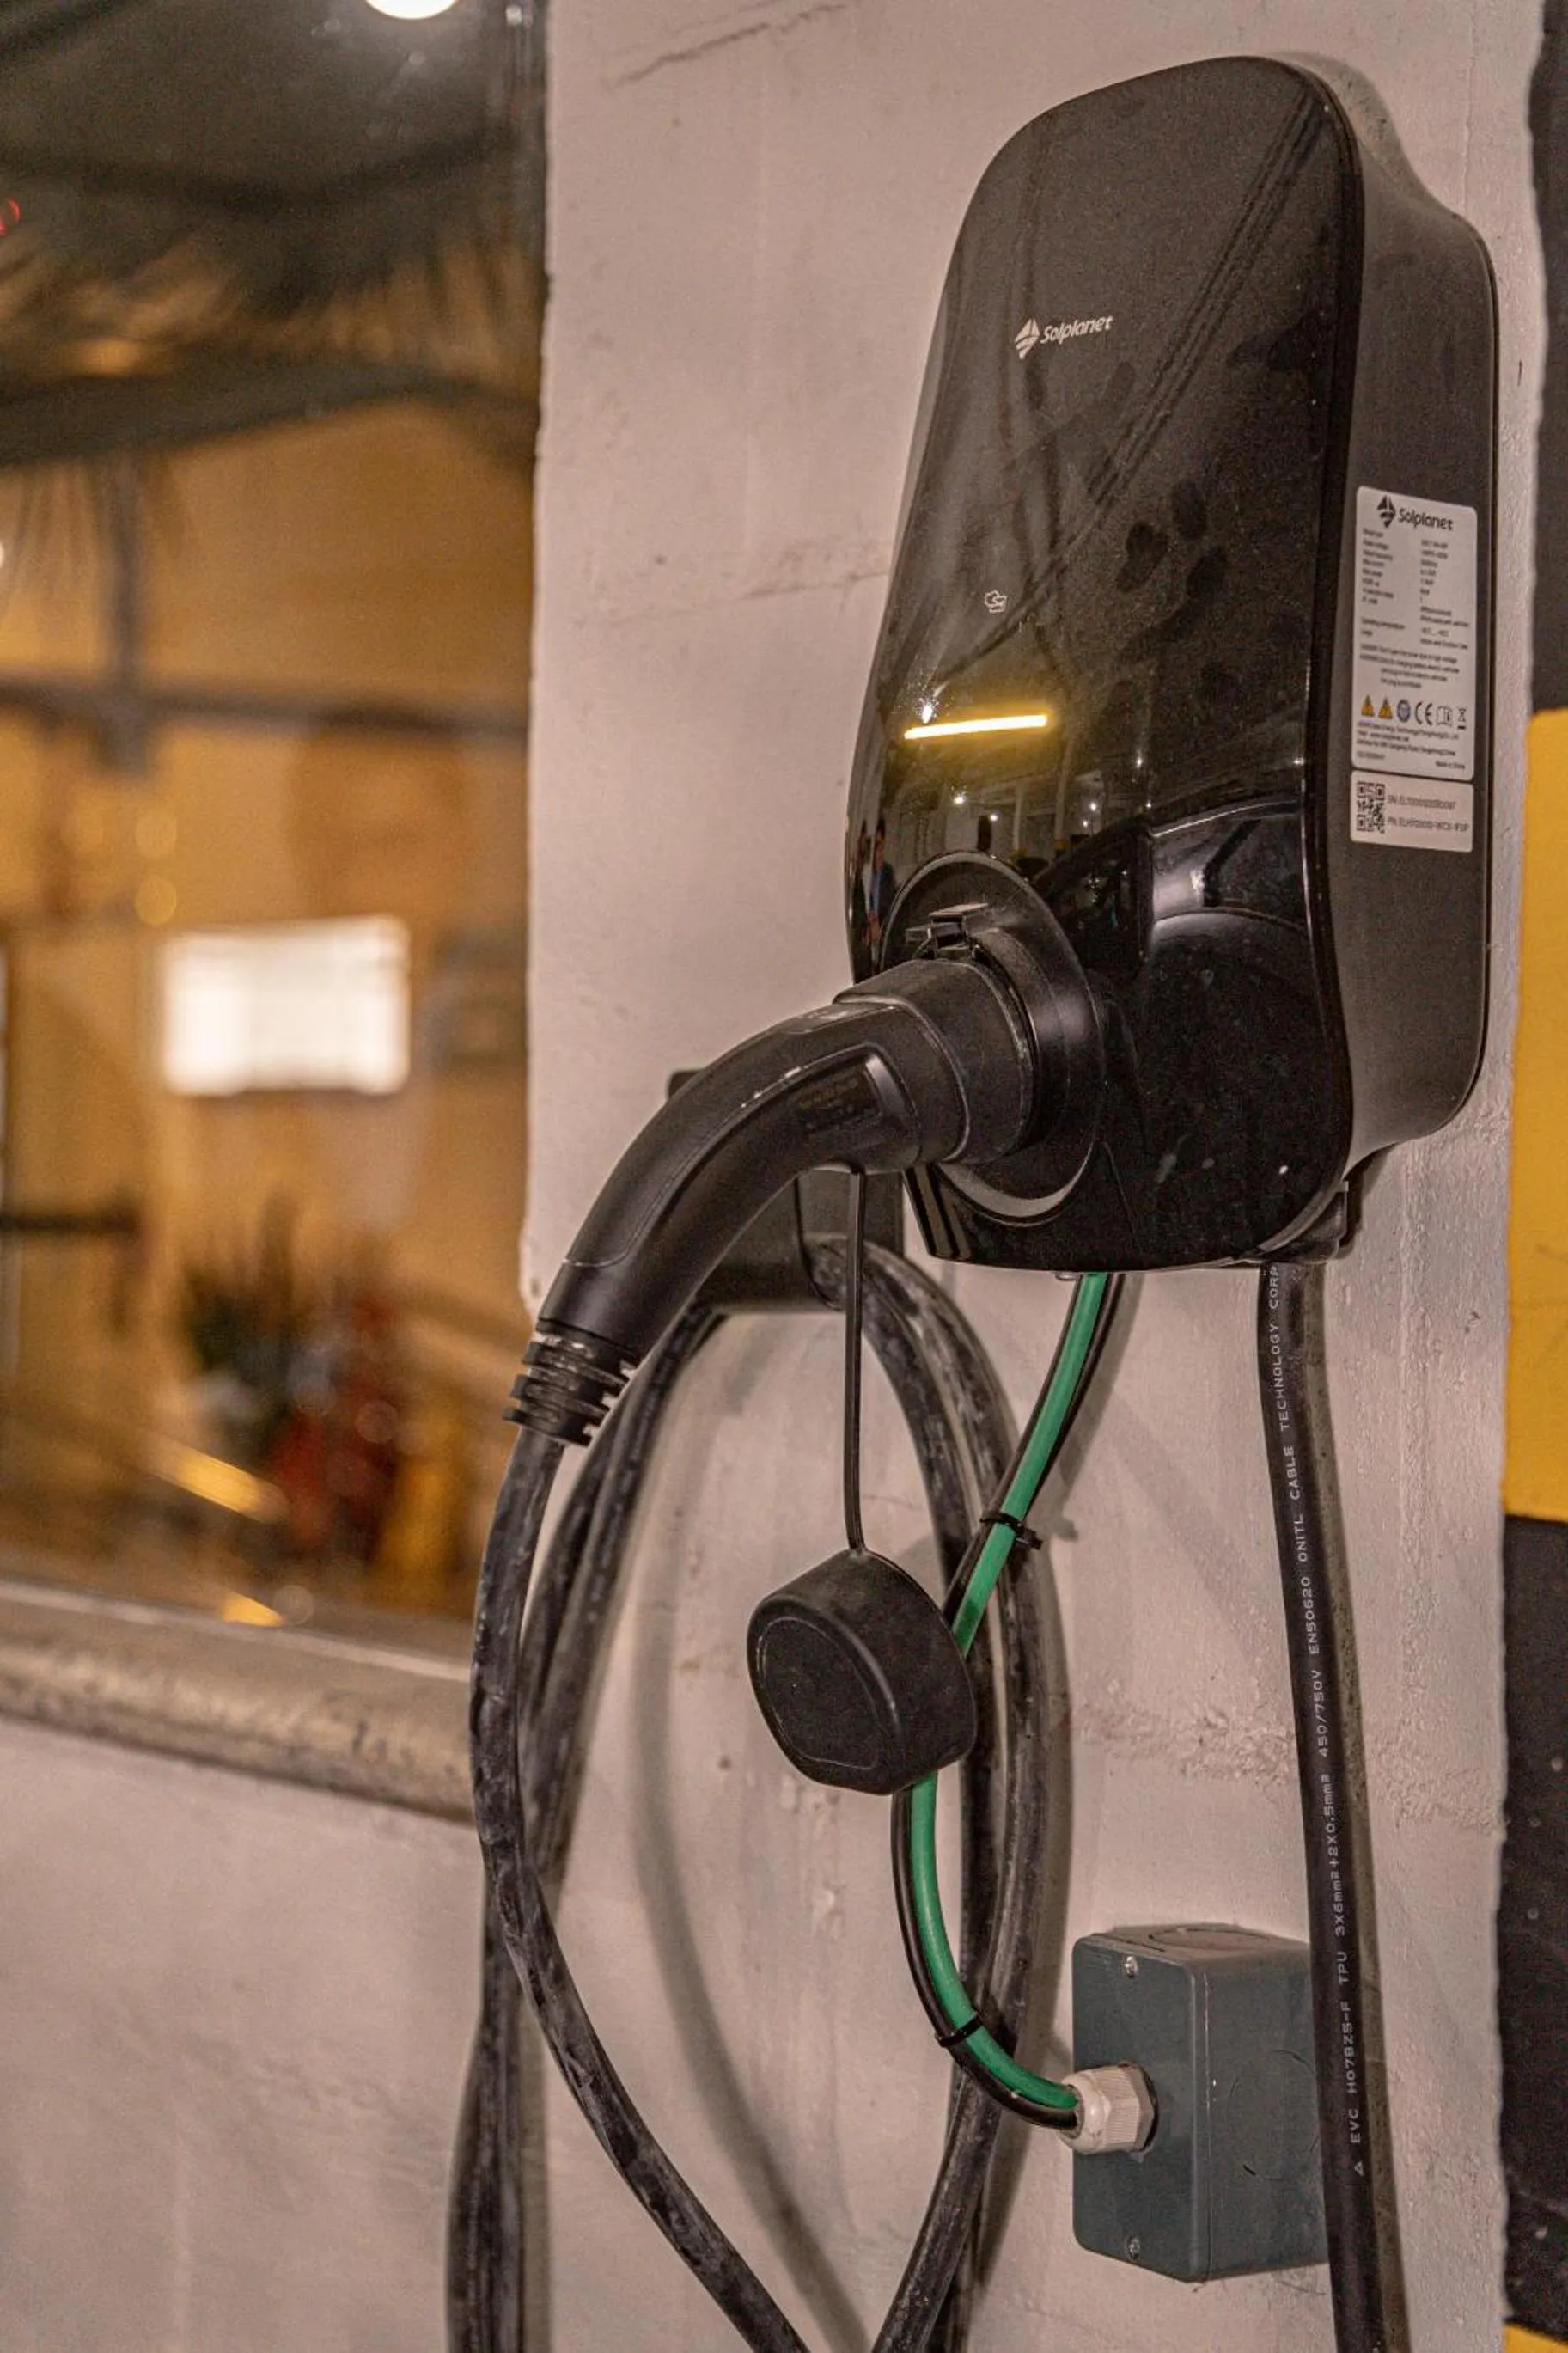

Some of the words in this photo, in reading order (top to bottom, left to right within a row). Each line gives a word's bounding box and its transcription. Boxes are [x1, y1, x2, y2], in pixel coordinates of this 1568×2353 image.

[1040, 315, 1113, 344] Solplanet
[1398, 507, 1454, 530] Solplanet
[1268, 1266, 1280, 1309] CORP
[1269, 1323, 1291, 1431] TECHNOLOGY
[1284, 1446, 1301, 1500] CABLE
[1294, 1513, 1308, 1562] ONITL
[1301, 1576, 1320, 1654] EN50620
[1311, 1670, 1329, 1757] 450/750V
[1336, 1951, 1350, 1985] TPU
[1349, 2108, 1361, 2143] EVC
